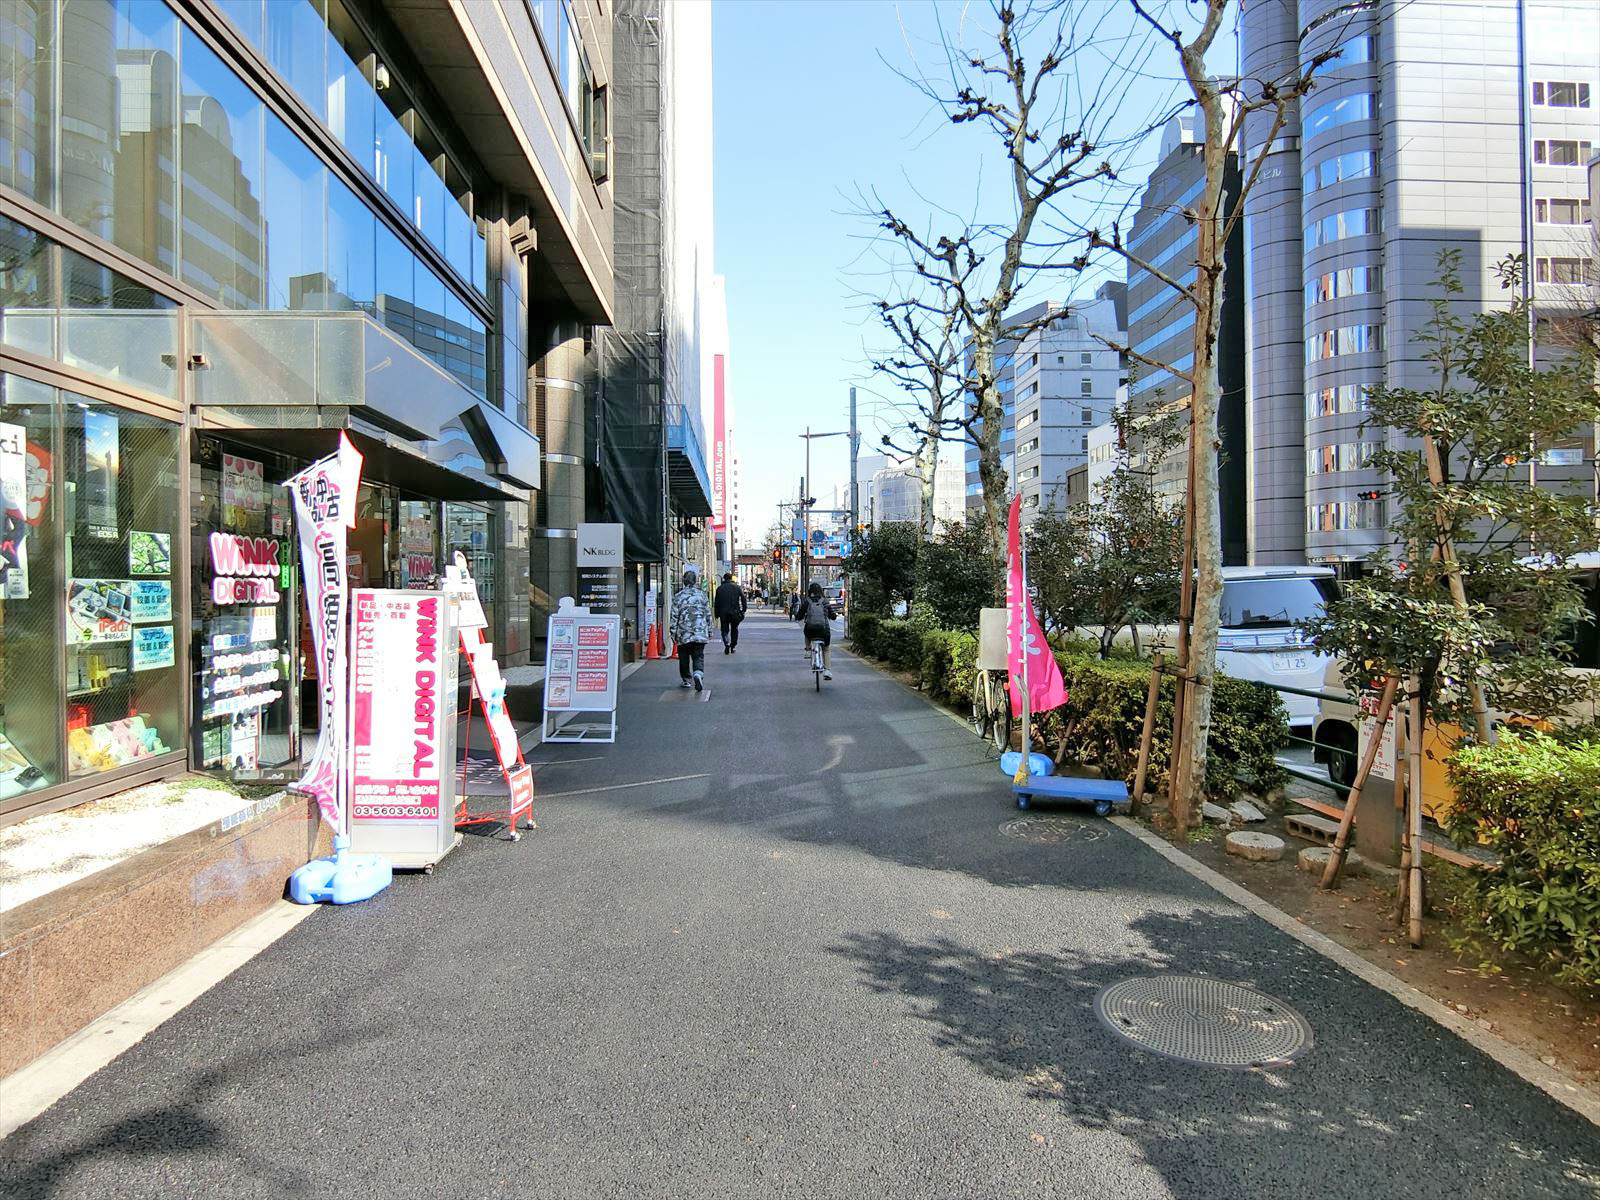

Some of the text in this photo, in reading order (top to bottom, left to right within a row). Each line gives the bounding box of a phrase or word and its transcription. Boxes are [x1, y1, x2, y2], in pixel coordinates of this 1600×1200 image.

[317, 477, 340, 517] 中古
[583, 547, 598, 555] NK
[140, 585, 164, 593] エアコン
[214, 578, 279, 603] DIGITAL
[142, 632, 166, 640] エアコン
[413, 670, 436, 778] DIGITAL
